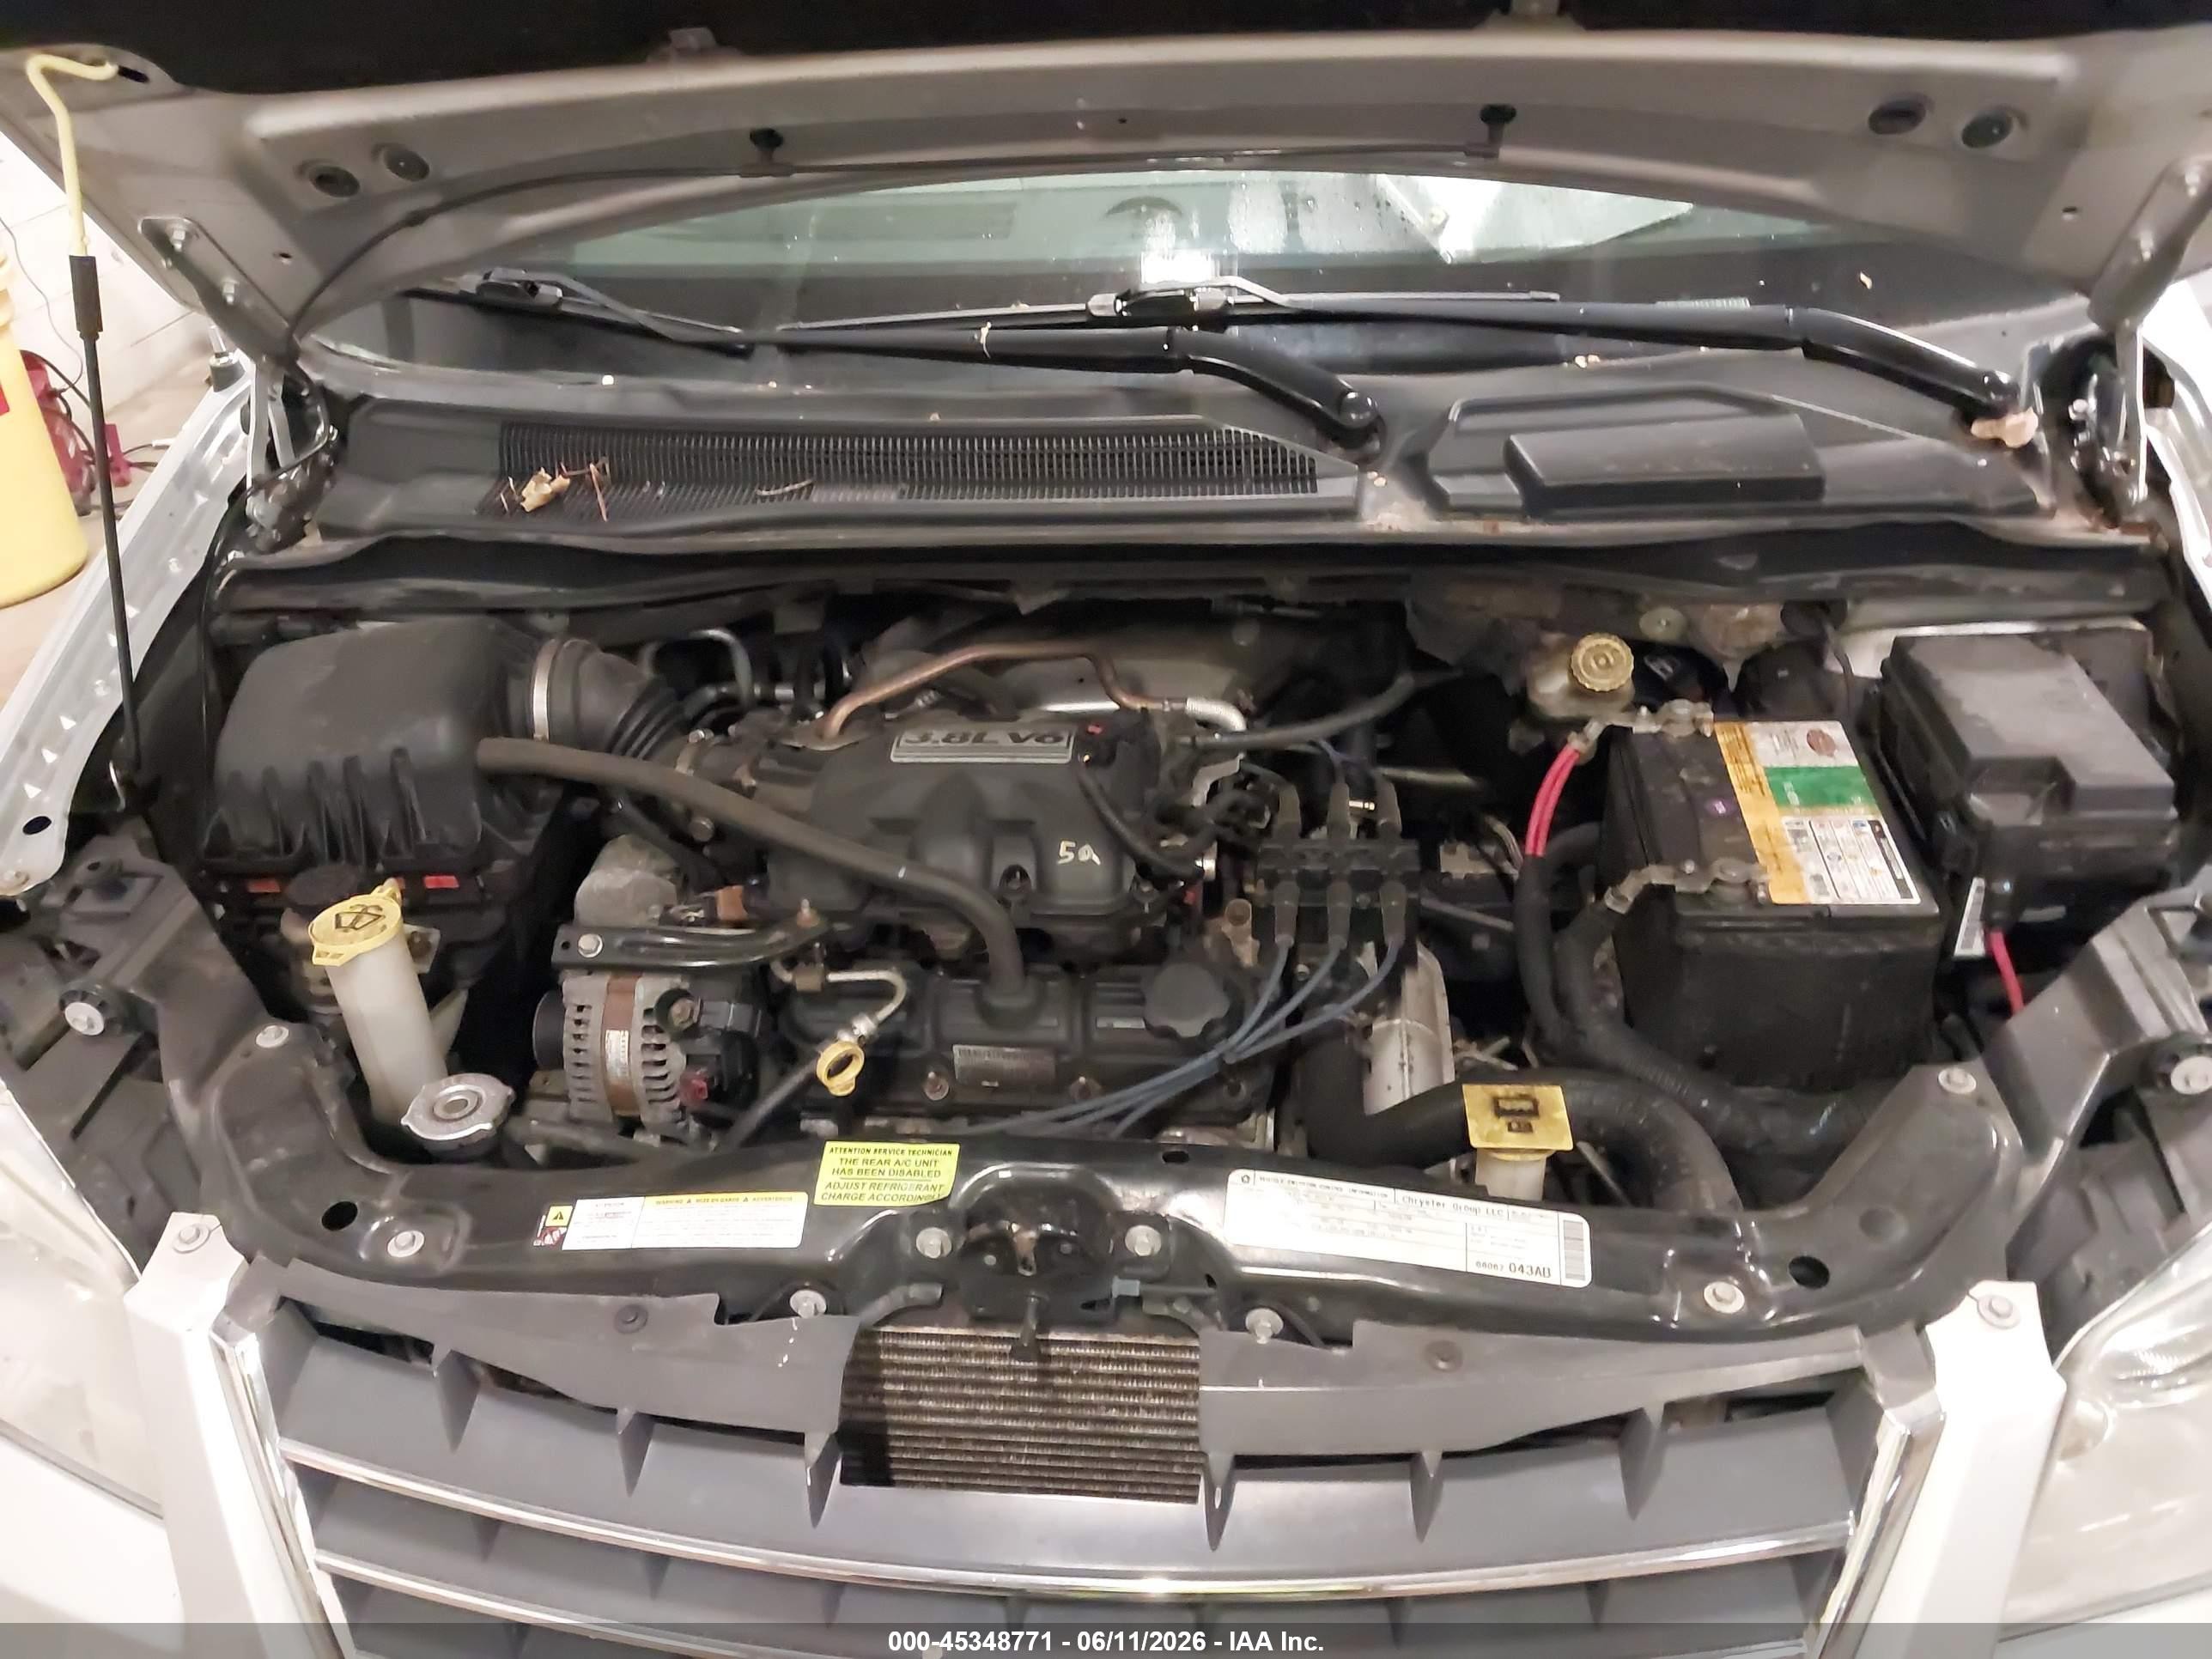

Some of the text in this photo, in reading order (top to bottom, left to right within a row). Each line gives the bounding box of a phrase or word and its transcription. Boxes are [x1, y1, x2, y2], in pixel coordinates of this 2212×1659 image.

[829, 1146, 872, 1155] ATTENTION
[839, 1158, 939, 1167] THE REAR A/C UNIT
[831, 1168, 942, 1177] HAS BEEN DISABLED
[824, 1182, 945, 1192] ADJUST REFRIGERANT
[820, 1193, 866, 1201] CHARGE
